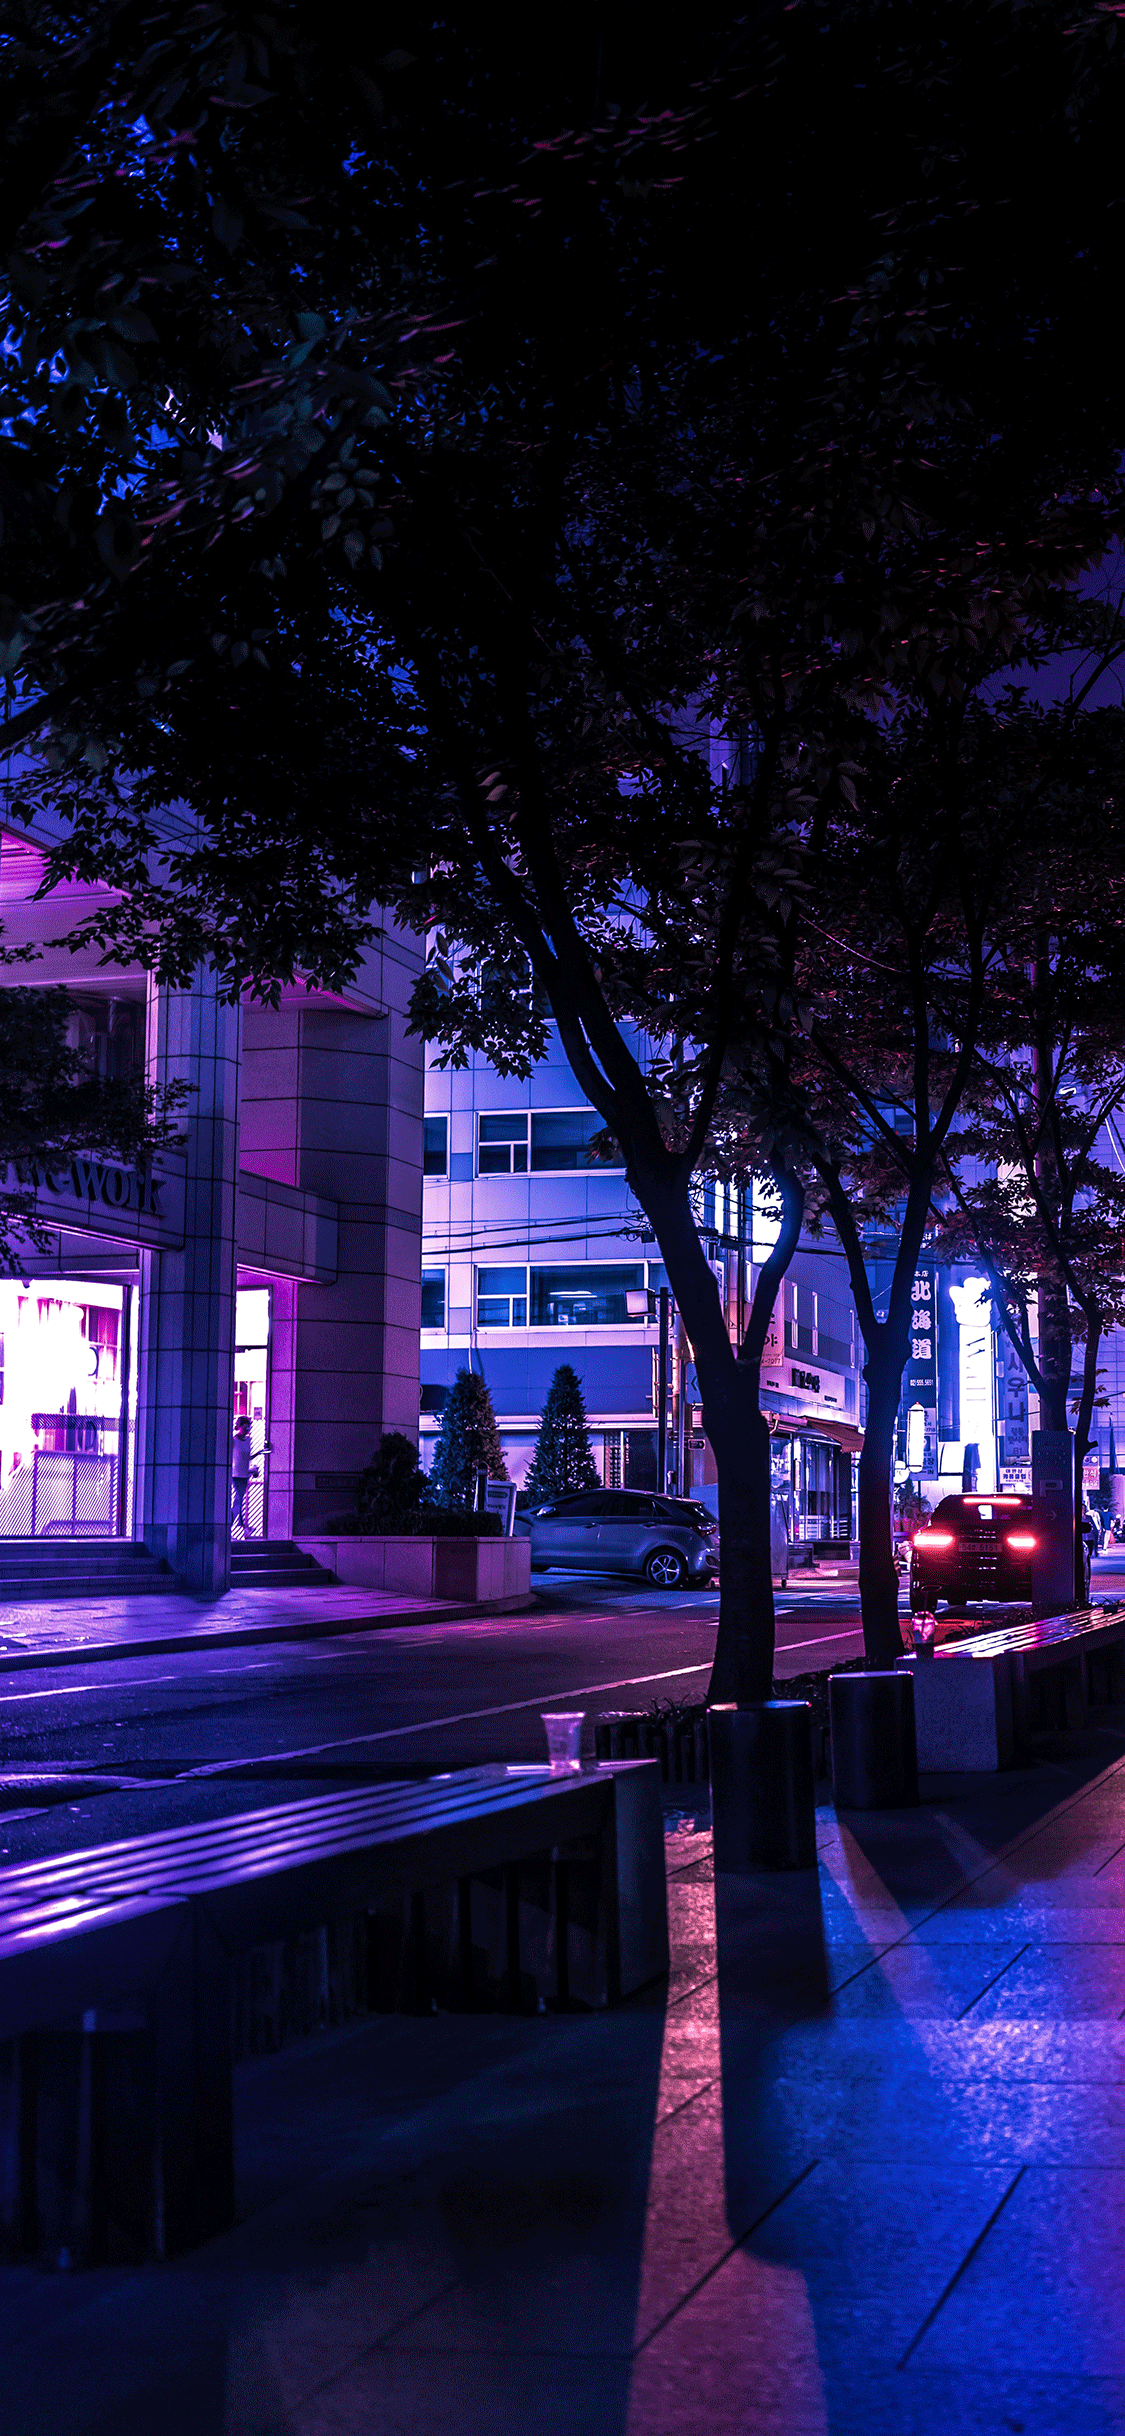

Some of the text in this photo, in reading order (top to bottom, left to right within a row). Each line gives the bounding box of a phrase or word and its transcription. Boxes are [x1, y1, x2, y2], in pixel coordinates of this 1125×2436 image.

[910, 1280, 932, 1359] 北海道
[1039, 1479, 1063, 1497] P
